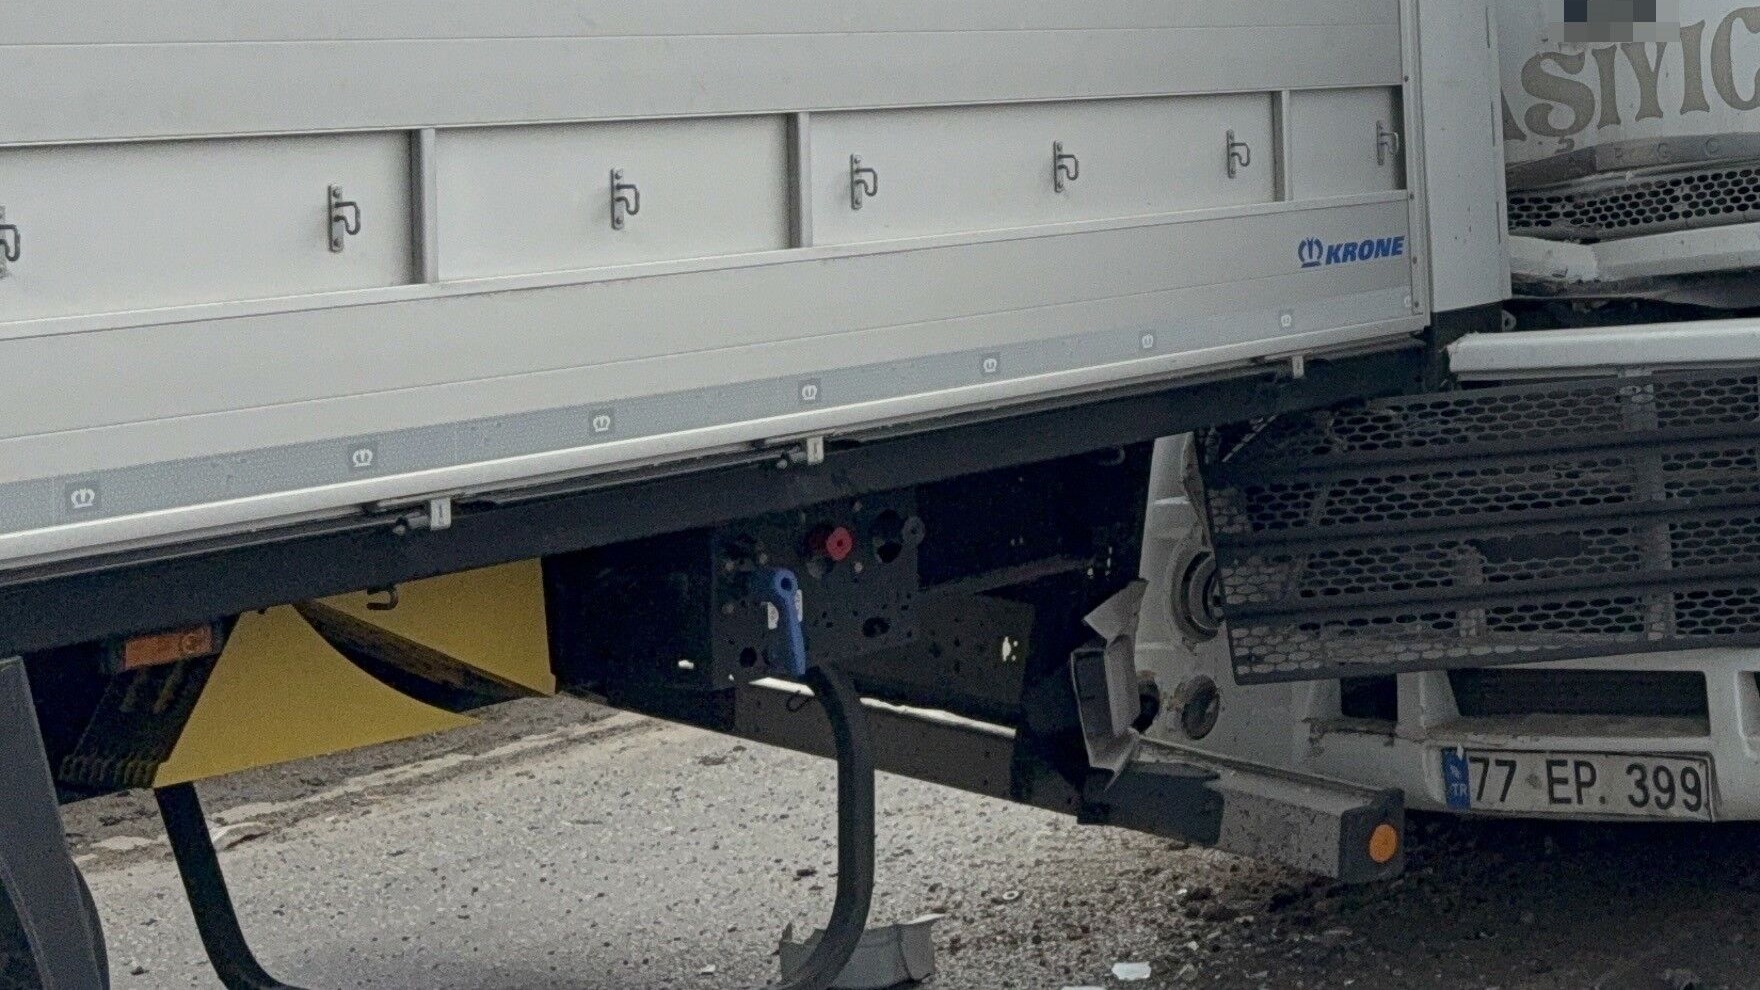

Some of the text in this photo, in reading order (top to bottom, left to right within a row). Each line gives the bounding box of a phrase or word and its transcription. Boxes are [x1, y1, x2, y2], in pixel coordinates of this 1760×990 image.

[1325, 235, 1405, 266] KRONE
[1469, 756, 1518, 803] 77
[1625, 763, 1701, 811] 399
